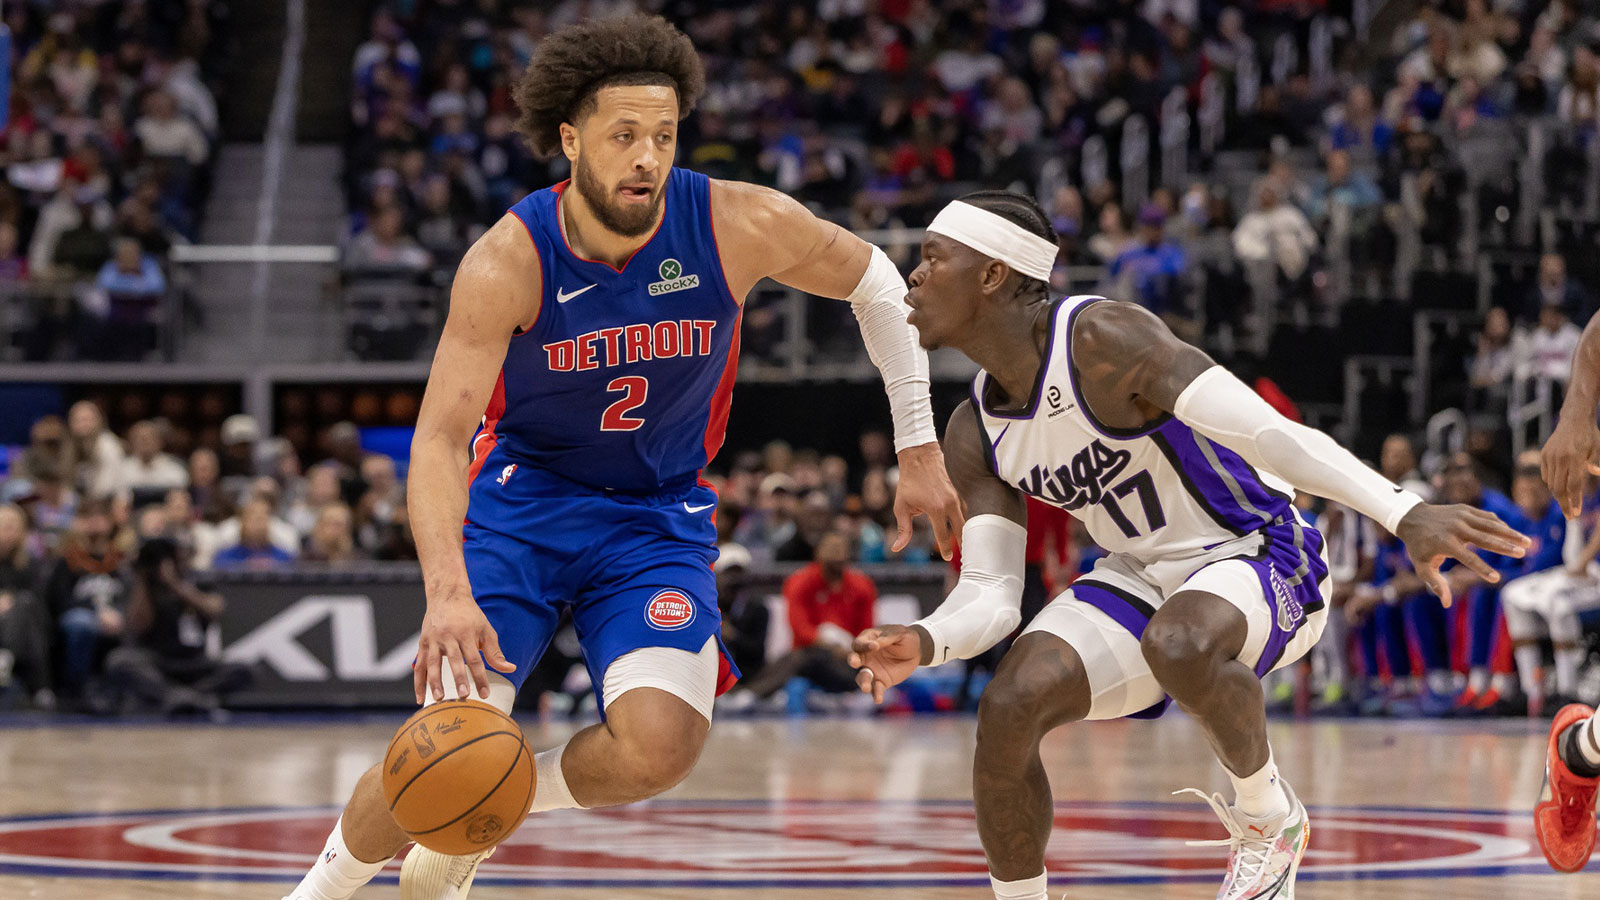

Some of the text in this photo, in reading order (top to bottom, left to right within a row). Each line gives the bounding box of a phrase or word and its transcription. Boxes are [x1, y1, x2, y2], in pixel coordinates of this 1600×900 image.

[650, 276, 697, 294] StockX
[543, 320, 716, 371] DETROIT
[600, 375, 648, 431] 2
[1018, 438, 1131, 511] Kings
[1098, 469, 1167, 539] 17
[655, 609, 685, 617] PISTONS
[656, 602, 686, 611] DETROIT
